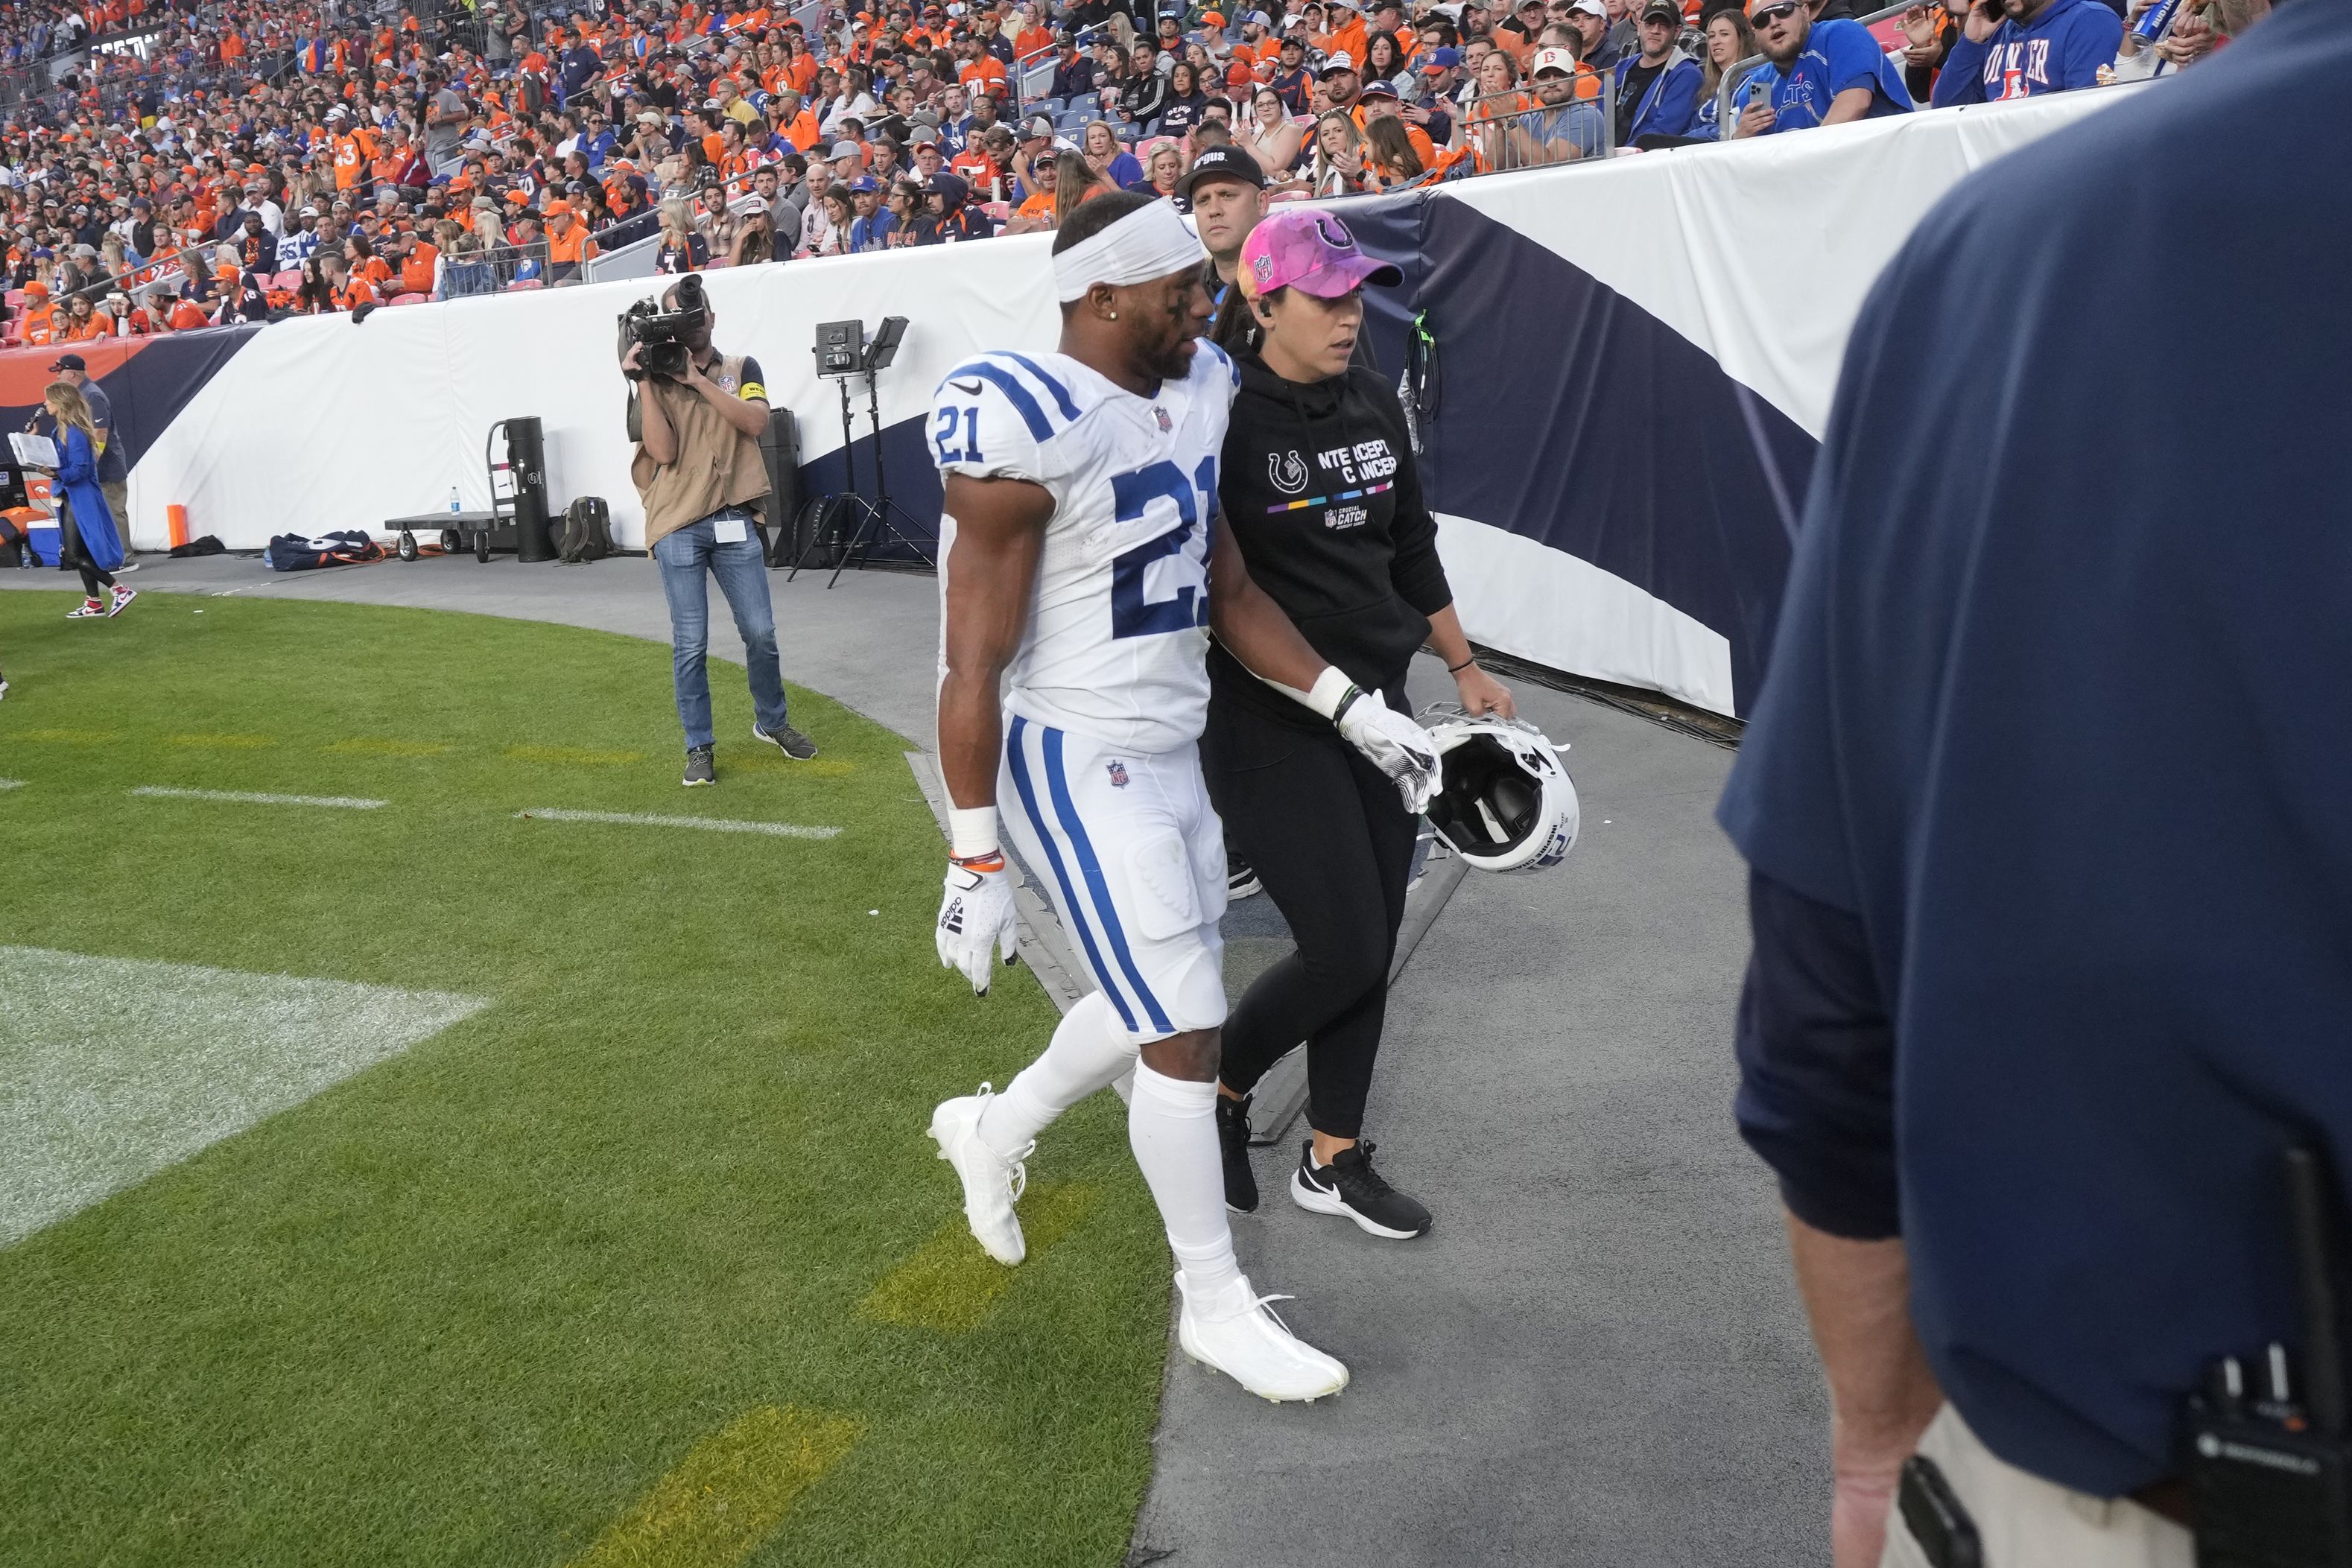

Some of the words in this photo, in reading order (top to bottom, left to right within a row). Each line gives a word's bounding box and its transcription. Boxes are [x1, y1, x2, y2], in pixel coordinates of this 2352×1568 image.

[2152, 9, 2166, 28] BUD
[1983, 39, 2050, 86] DNER
[335, 145, 356, 168] 43
[1257, 266, 1272, 279] NFL
[721, 381, 734, 393] NFL
[936, 405, 983, 464] 21
[1317, 439, 1390, 470] NTECEPT
[1337, 509, 1368, 526] CATCH
[1338, 505, 1360, 514] CRUCIAL
[1110, 455, 1220, 641] 21
[1535, 825, 1558, 859] INSPIRE
[1497, 858, 1536, 874] CHANGE
[940, 896, 963, 929] adidas
